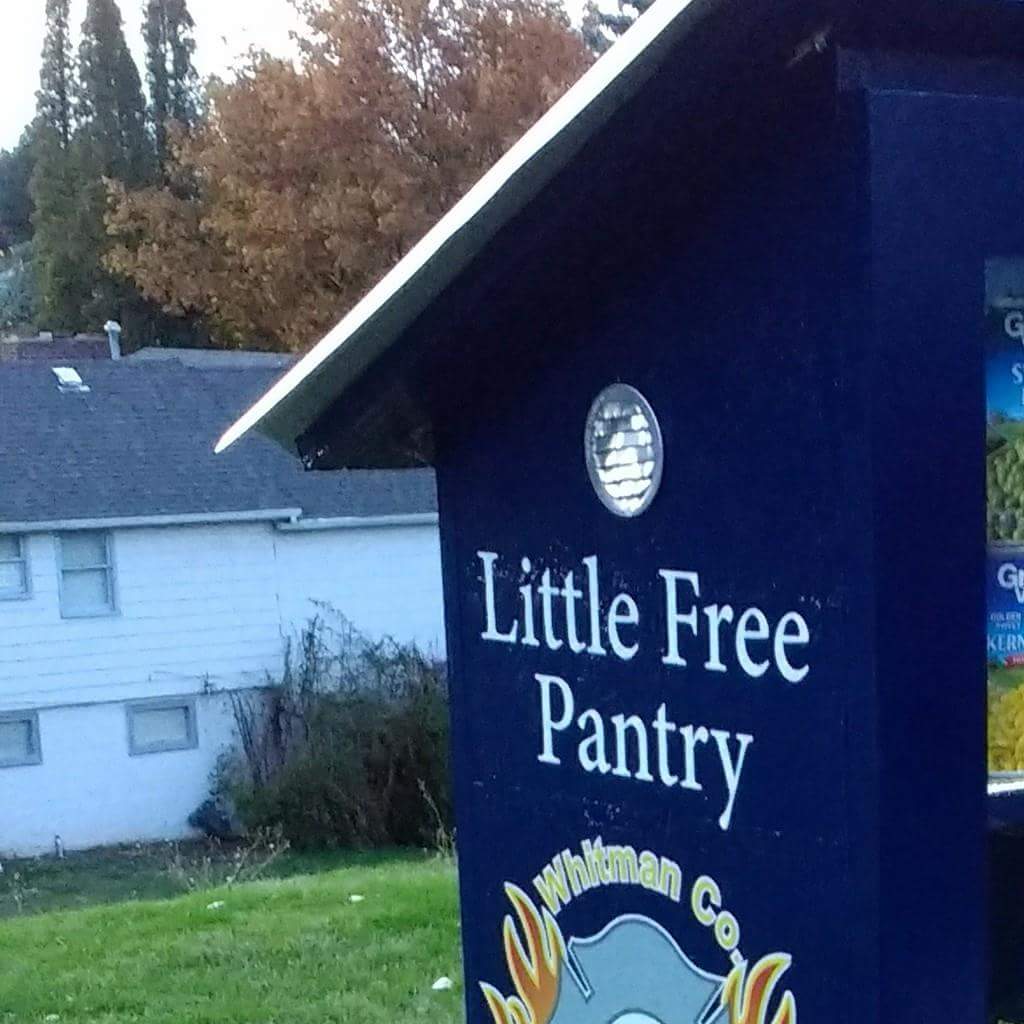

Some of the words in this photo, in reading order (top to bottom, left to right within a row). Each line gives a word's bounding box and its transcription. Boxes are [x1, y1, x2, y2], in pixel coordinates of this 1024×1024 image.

[477, 551, 639, 660] Little
[658, 568, 810, 683] Free
[534, 673, 754, 831] Pantry
[533, 836, 682, 915] Whitman
